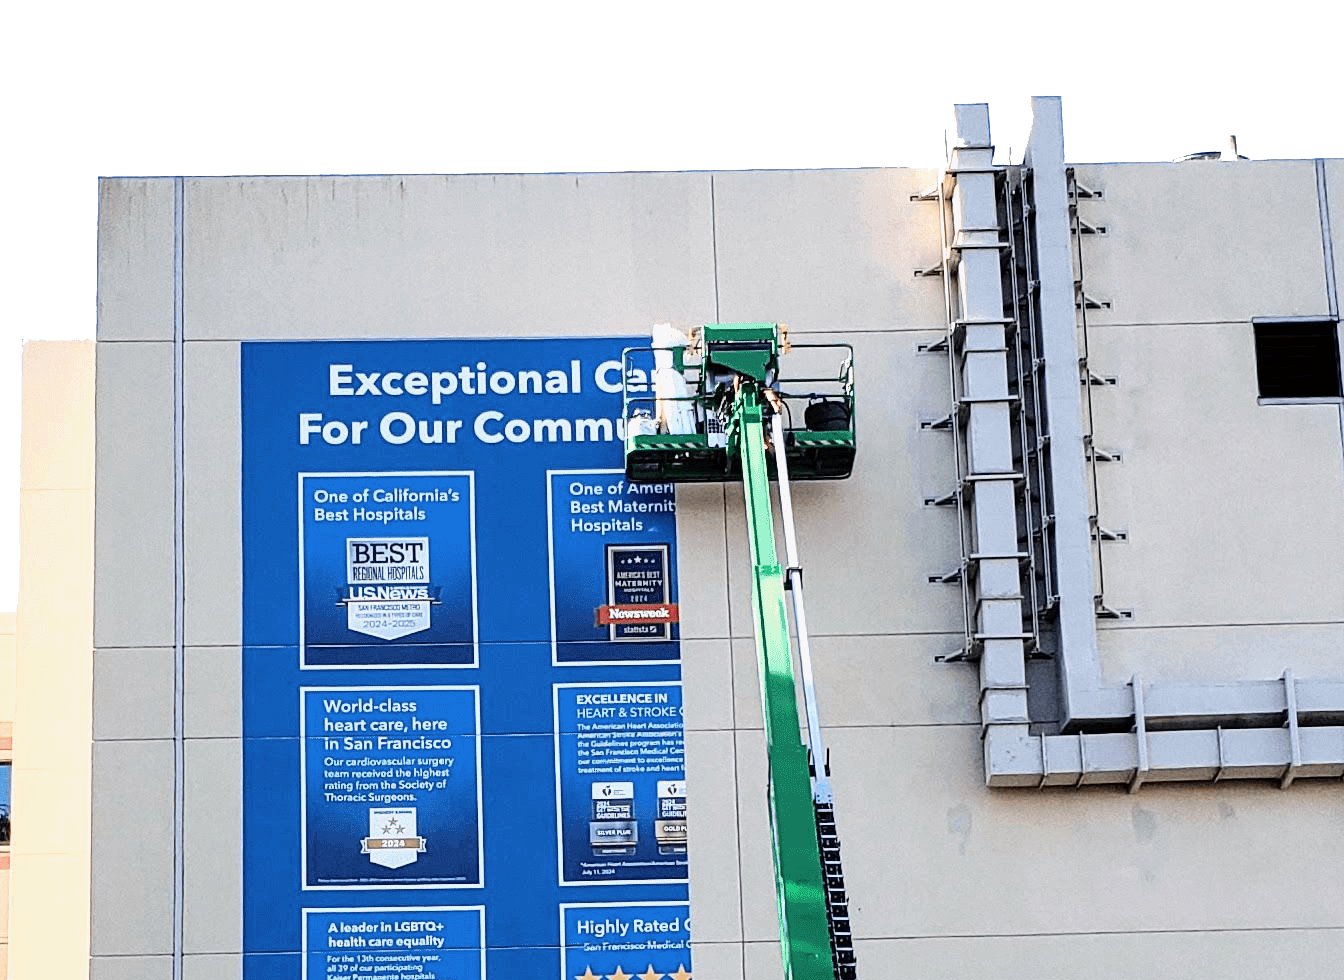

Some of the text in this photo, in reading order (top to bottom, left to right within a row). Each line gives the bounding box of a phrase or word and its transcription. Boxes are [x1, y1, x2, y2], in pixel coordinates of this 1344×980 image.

[329, 360, 581, 404] Exceptional
[299, 413, 368, 444] For
[380, 412, 462, 444] Our
[570, 482, 603, 495] One
[608, 481, 624, 494] of
[314, 488, 460, 503] One of California's
[571, 501, 604, 514] Best
[314, 507, 426, 525] Best Hospitals
[572, 517, 643, 535] Hospitals
[352, 543, 423, 563] BEST
[353, 566, 424, 580] REGIONAL HOSPITALS
[324, 698, 417, 712] World-class
[577, 694, 667, 704] EXCELLENCE IN
[577, 708, 615, 718] HEART
[619, 707, 627, 717] &
[630, 707, 676, 717] STROKE
[324, 717, 447, 732] heart care, here
[325, 736, 451, 750] in San Francisco
[324, 756, 454, 767] Our cardiovascular surgery
[324, 768, 449, 779] team received the highest
[325, 779, 447, 791] rating from the Society of
[324, 793, 366, 801] Thoracic
[328, 922, 444, 933] A leader in LGBTQ+
[577, 917, 679, 937] Highly Rated
[329, 936, 444, 948] health care equality
[584, 940, 684, 951] San Francisco Medical
[375, 954, 420, 962] consecutive
[401, 972, 435, 980] hospitals
